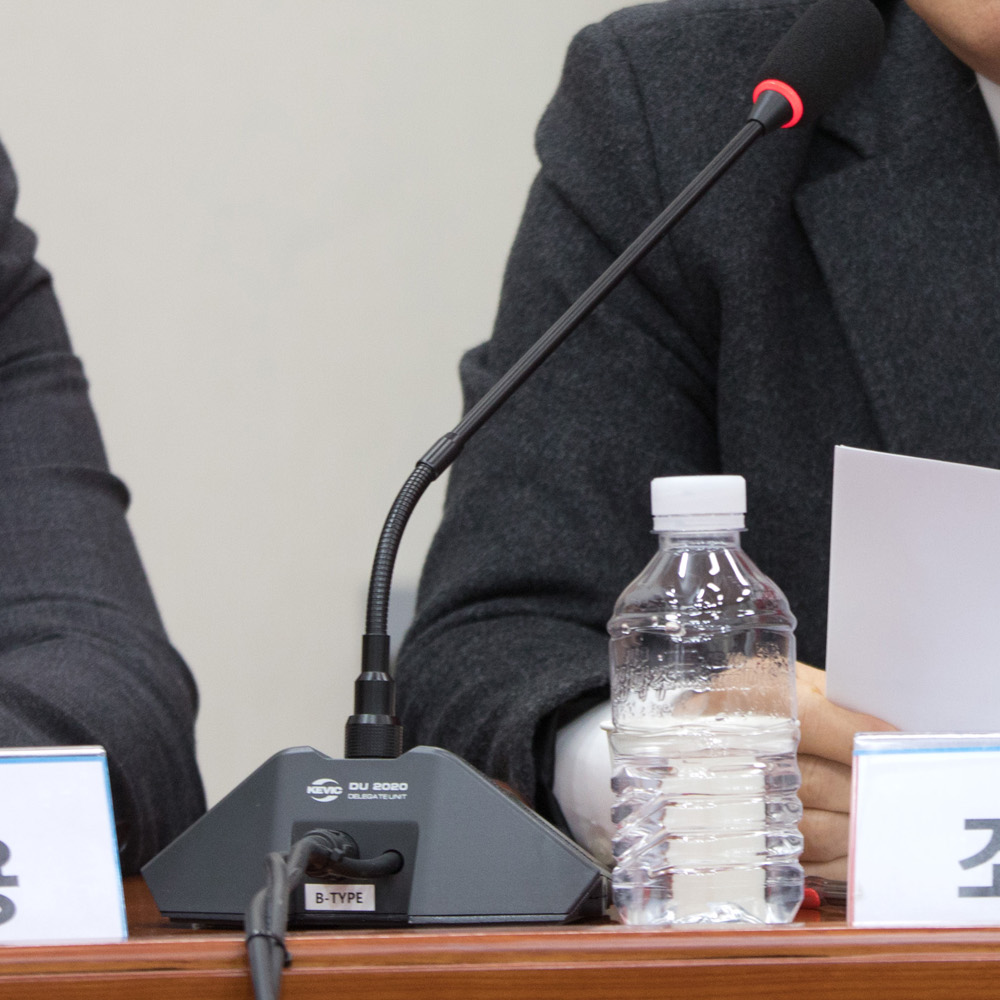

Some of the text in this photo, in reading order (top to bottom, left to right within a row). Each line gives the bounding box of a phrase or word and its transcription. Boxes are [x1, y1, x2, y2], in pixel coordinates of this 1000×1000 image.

[306, 785, 343, 795] KEVIC
[348, 782, 409, 791] DU 2020
[315, 892, 363, 904] B-TYPE
